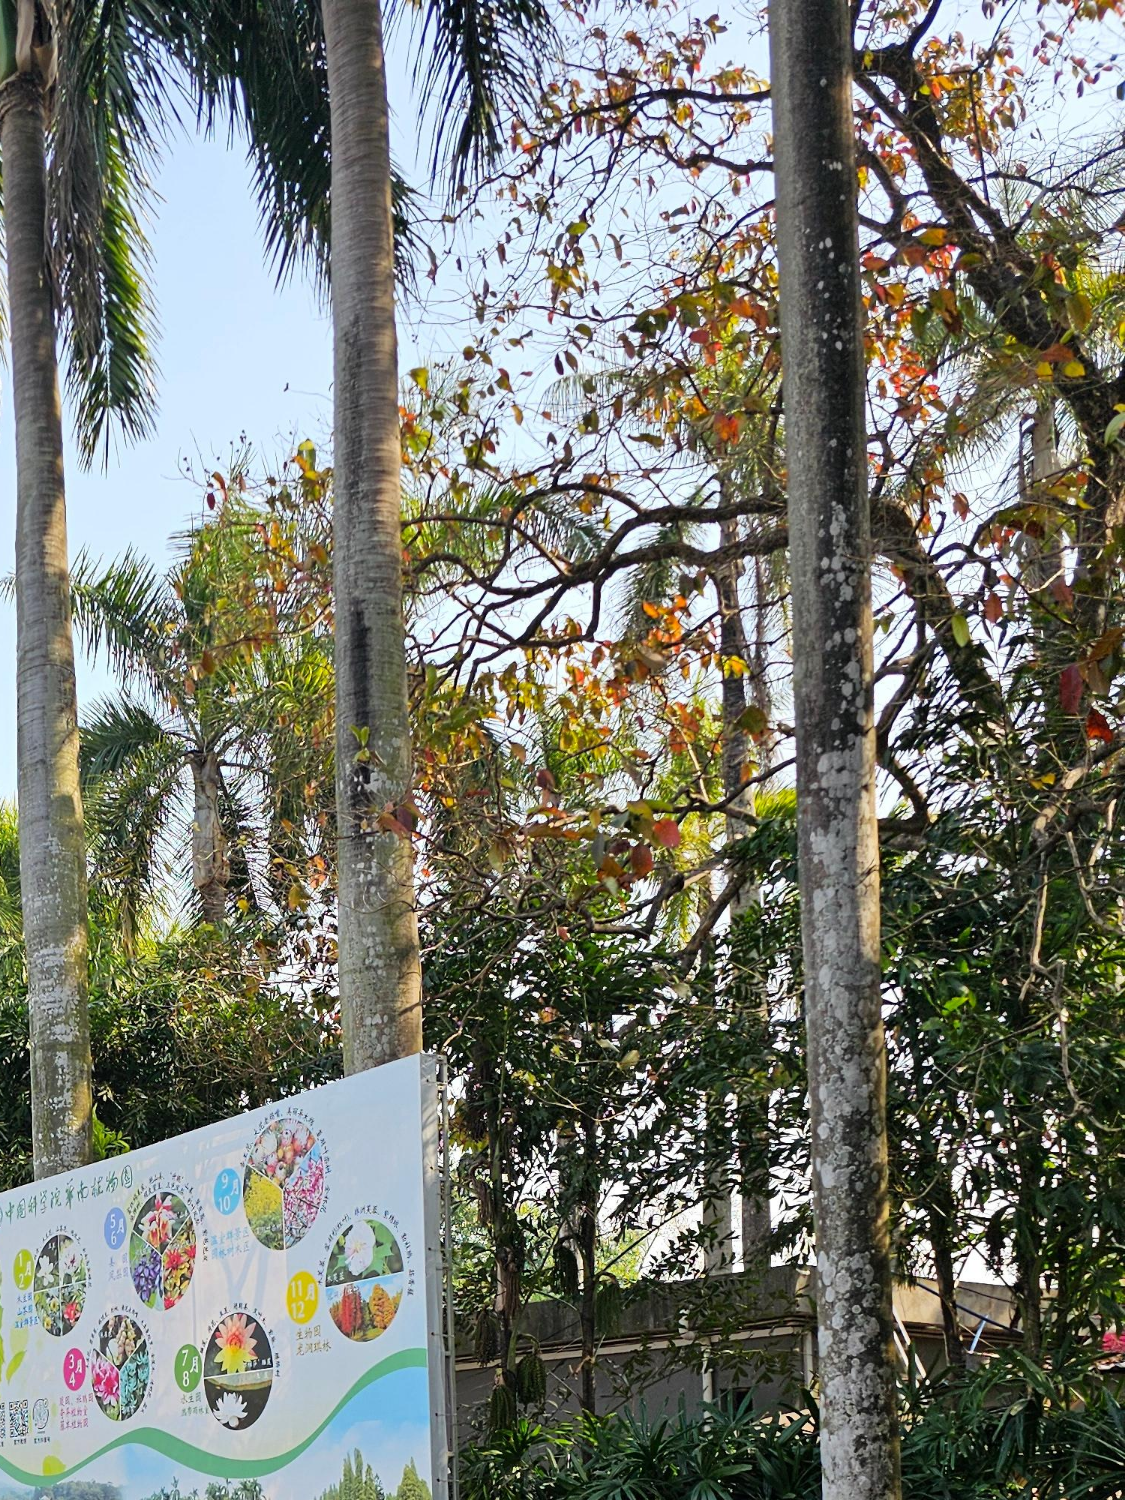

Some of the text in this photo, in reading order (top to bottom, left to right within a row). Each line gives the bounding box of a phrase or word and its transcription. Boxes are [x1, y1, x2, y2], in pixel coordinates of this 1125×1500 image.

[221, 1173, 228, 1189] 9
[219, 1197, 231, 1212] 10
[110, 1213, 116, 1228] 5
[111, 1230, 117, 1245] 6
[18, 1274, 25, 1289] 2
[290, 1280, 303, 1299] 11
[291, 1301, 305, 1319] 12
[68, 1354, 75, 1369] 3
[181, 1349, 189, 1367] 7
[68, 1371, 76, 1386] 4
[182, 1371, 190, 1387] 8
